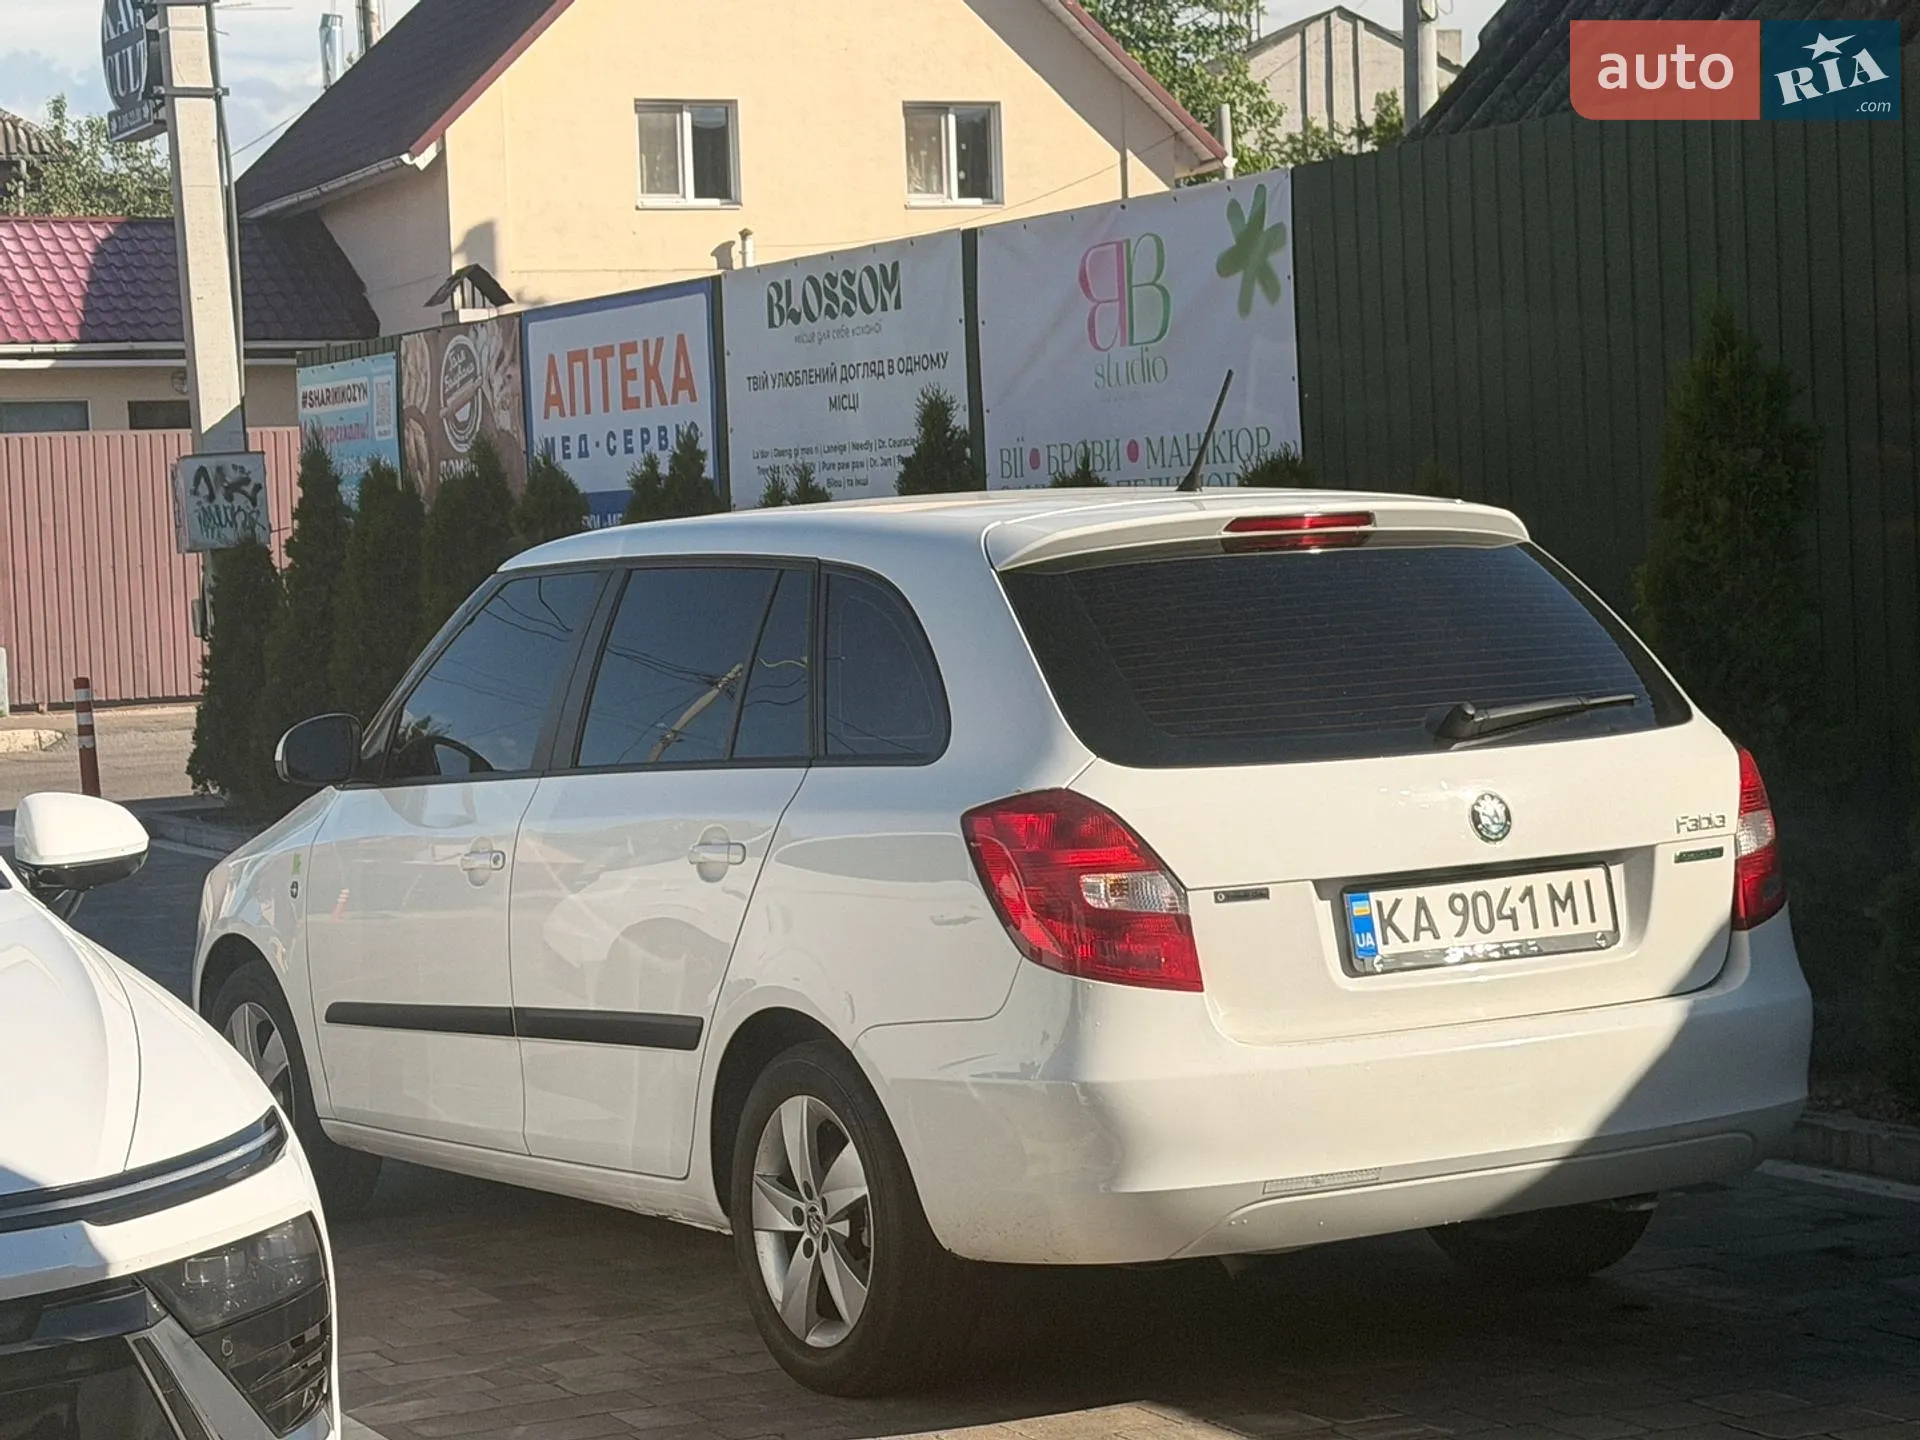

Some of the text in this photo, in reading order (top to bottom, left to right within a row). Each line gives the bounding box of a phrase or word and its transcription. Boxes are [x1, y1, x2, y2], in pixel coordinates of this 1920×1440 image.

[766, 260, 902, 329] BLOSSOM
[543, 333, 698, 420] АПТЕКА
[746, 352, 949, 393] ТВІЙ УЛЮБЛЕНИЙ ДОГЛЯД В ОДНОМУ
[1094, 346, 1168, 390] studio
[828, 391, 859, 413] МІСЦІ
[1000, 426, 1272, 478] ВІЇ БРОВИ МАНІКЮР
[1675, 813, 1726, 834] Fabia
[1376, 879, 1597, 946] KA 9041 MI
[1355, 933, 1376, 948] UA
